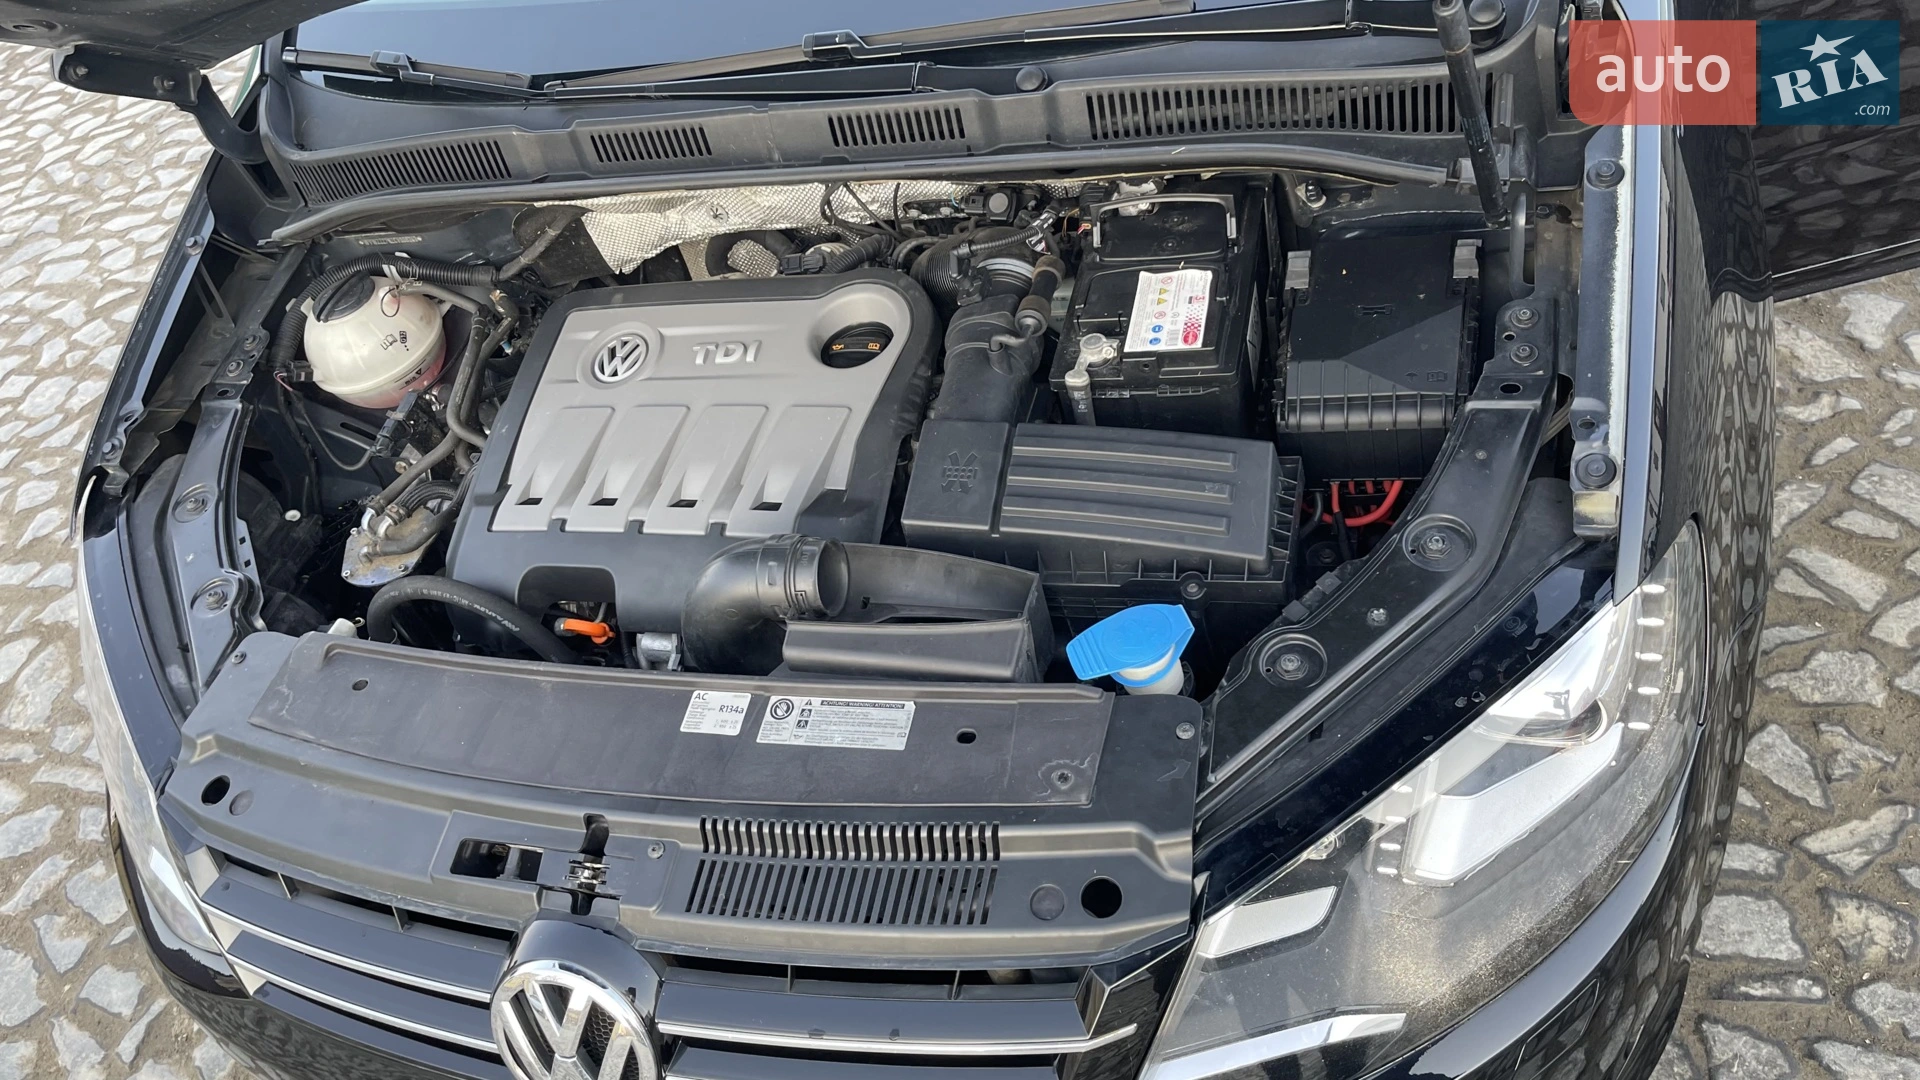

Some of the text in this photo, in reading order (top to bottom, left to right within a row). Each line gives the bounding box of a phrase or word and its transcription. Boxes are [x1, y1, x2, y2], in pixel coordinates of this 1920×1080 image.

[692, 340, 763, 366] TDI
[693, 692, 709, 701] AC
[718, 704, 745, 714] R134a
